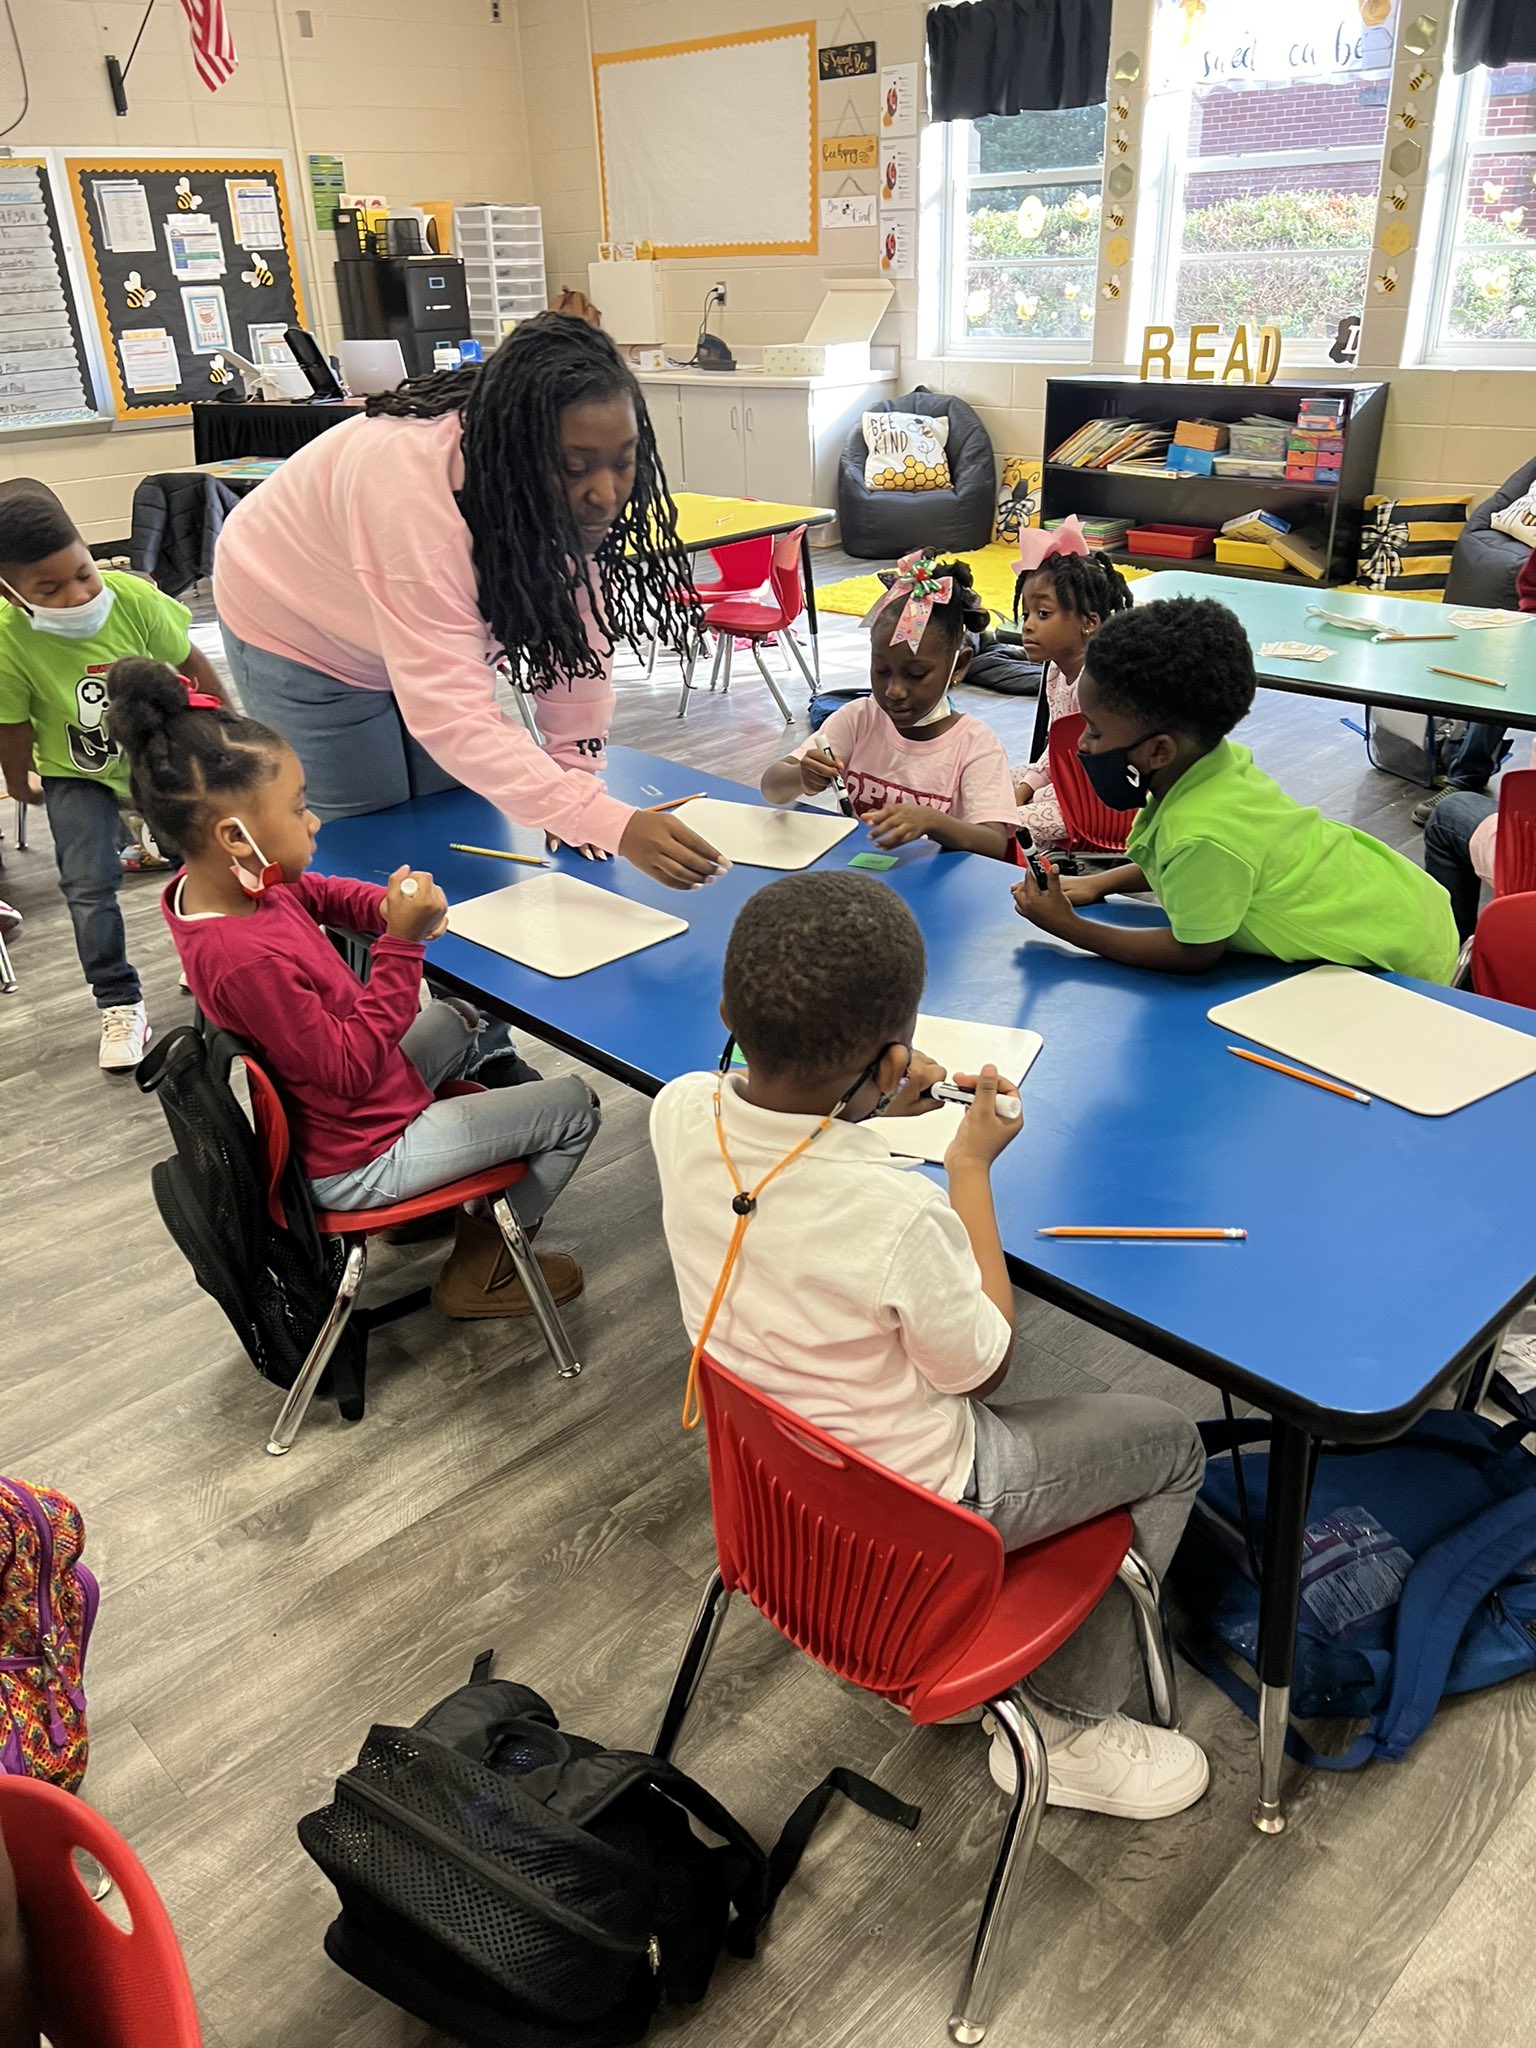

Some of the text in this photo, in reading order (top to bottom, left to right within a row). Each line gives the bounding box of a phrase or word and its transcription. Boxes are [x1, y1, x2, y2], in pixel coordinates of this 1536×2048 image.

[1140, 324, 1282, 384] READ
[870, 413, 897, 436] BEE
[873, 431, 908, 455] KIND
